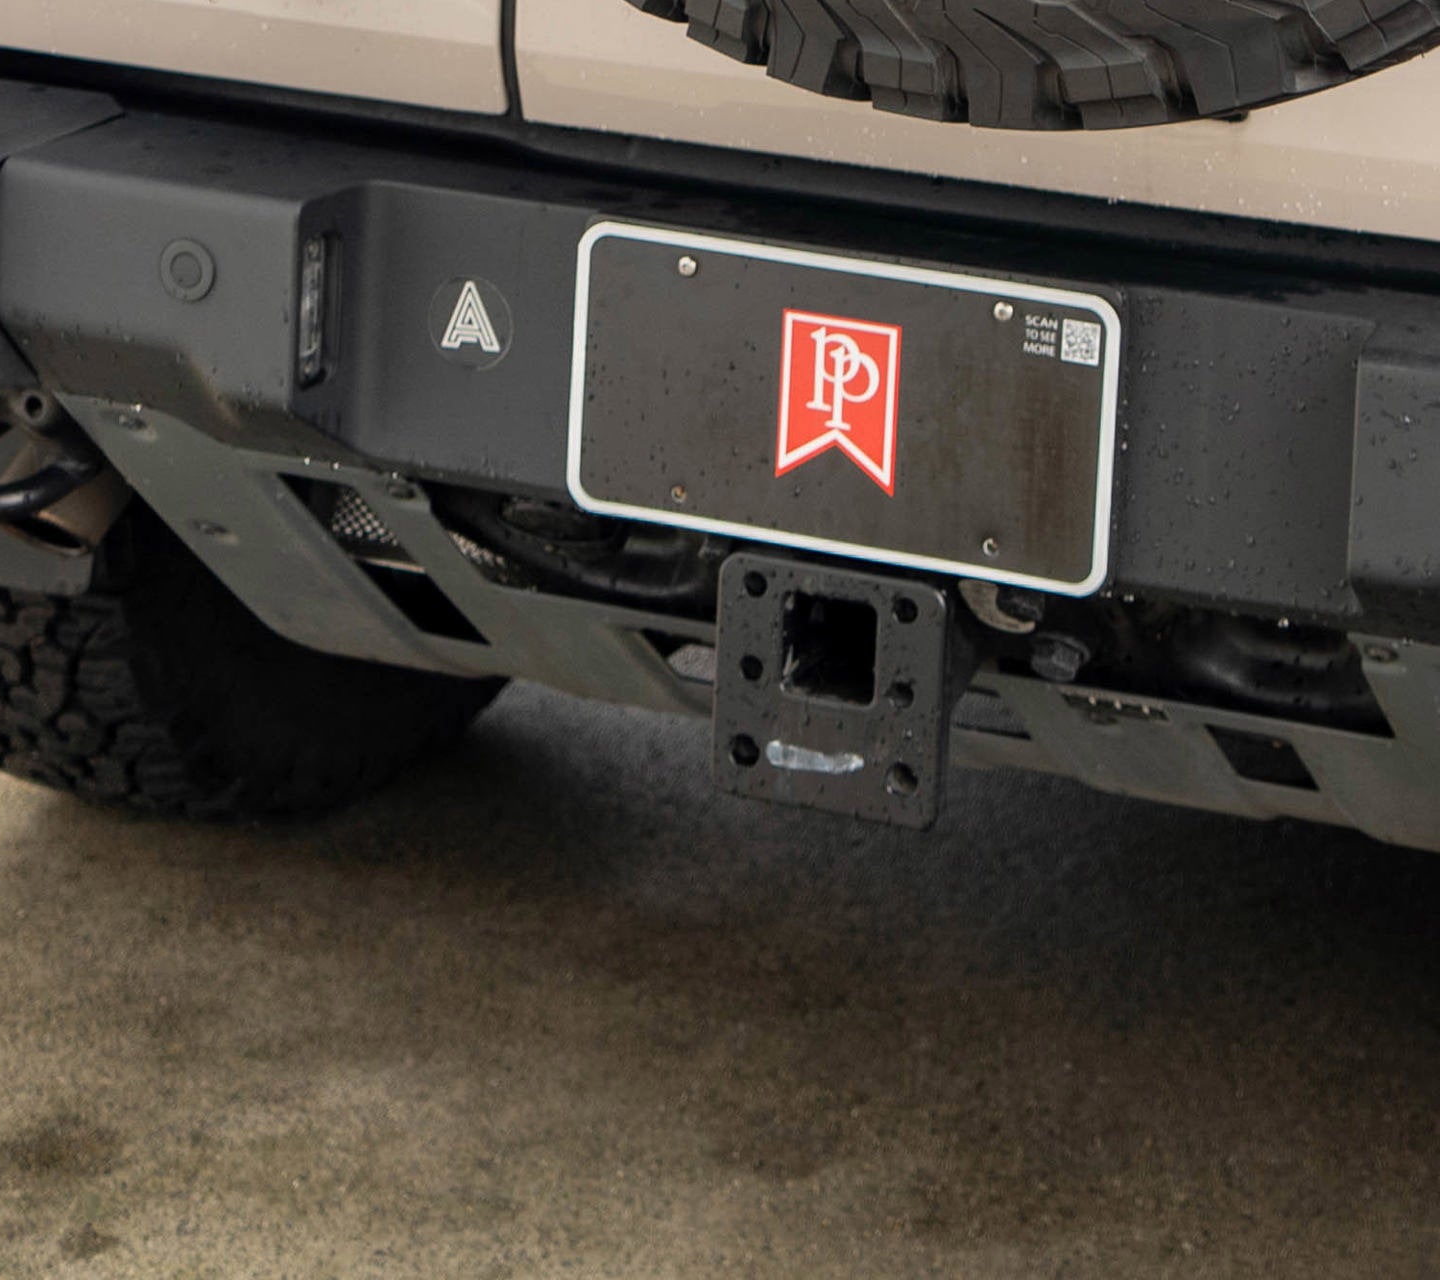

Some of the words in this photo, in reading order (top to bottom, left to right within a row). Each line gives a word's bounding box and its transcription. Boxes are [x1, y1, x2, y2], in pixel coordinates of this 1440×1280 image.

[1024, 314, 1059, 330] SCAN
[1025, 328, 1039, 341] TO
[1040, 331, 1057, 344] SEE
[1023, 341, 1056, 358] MORE
